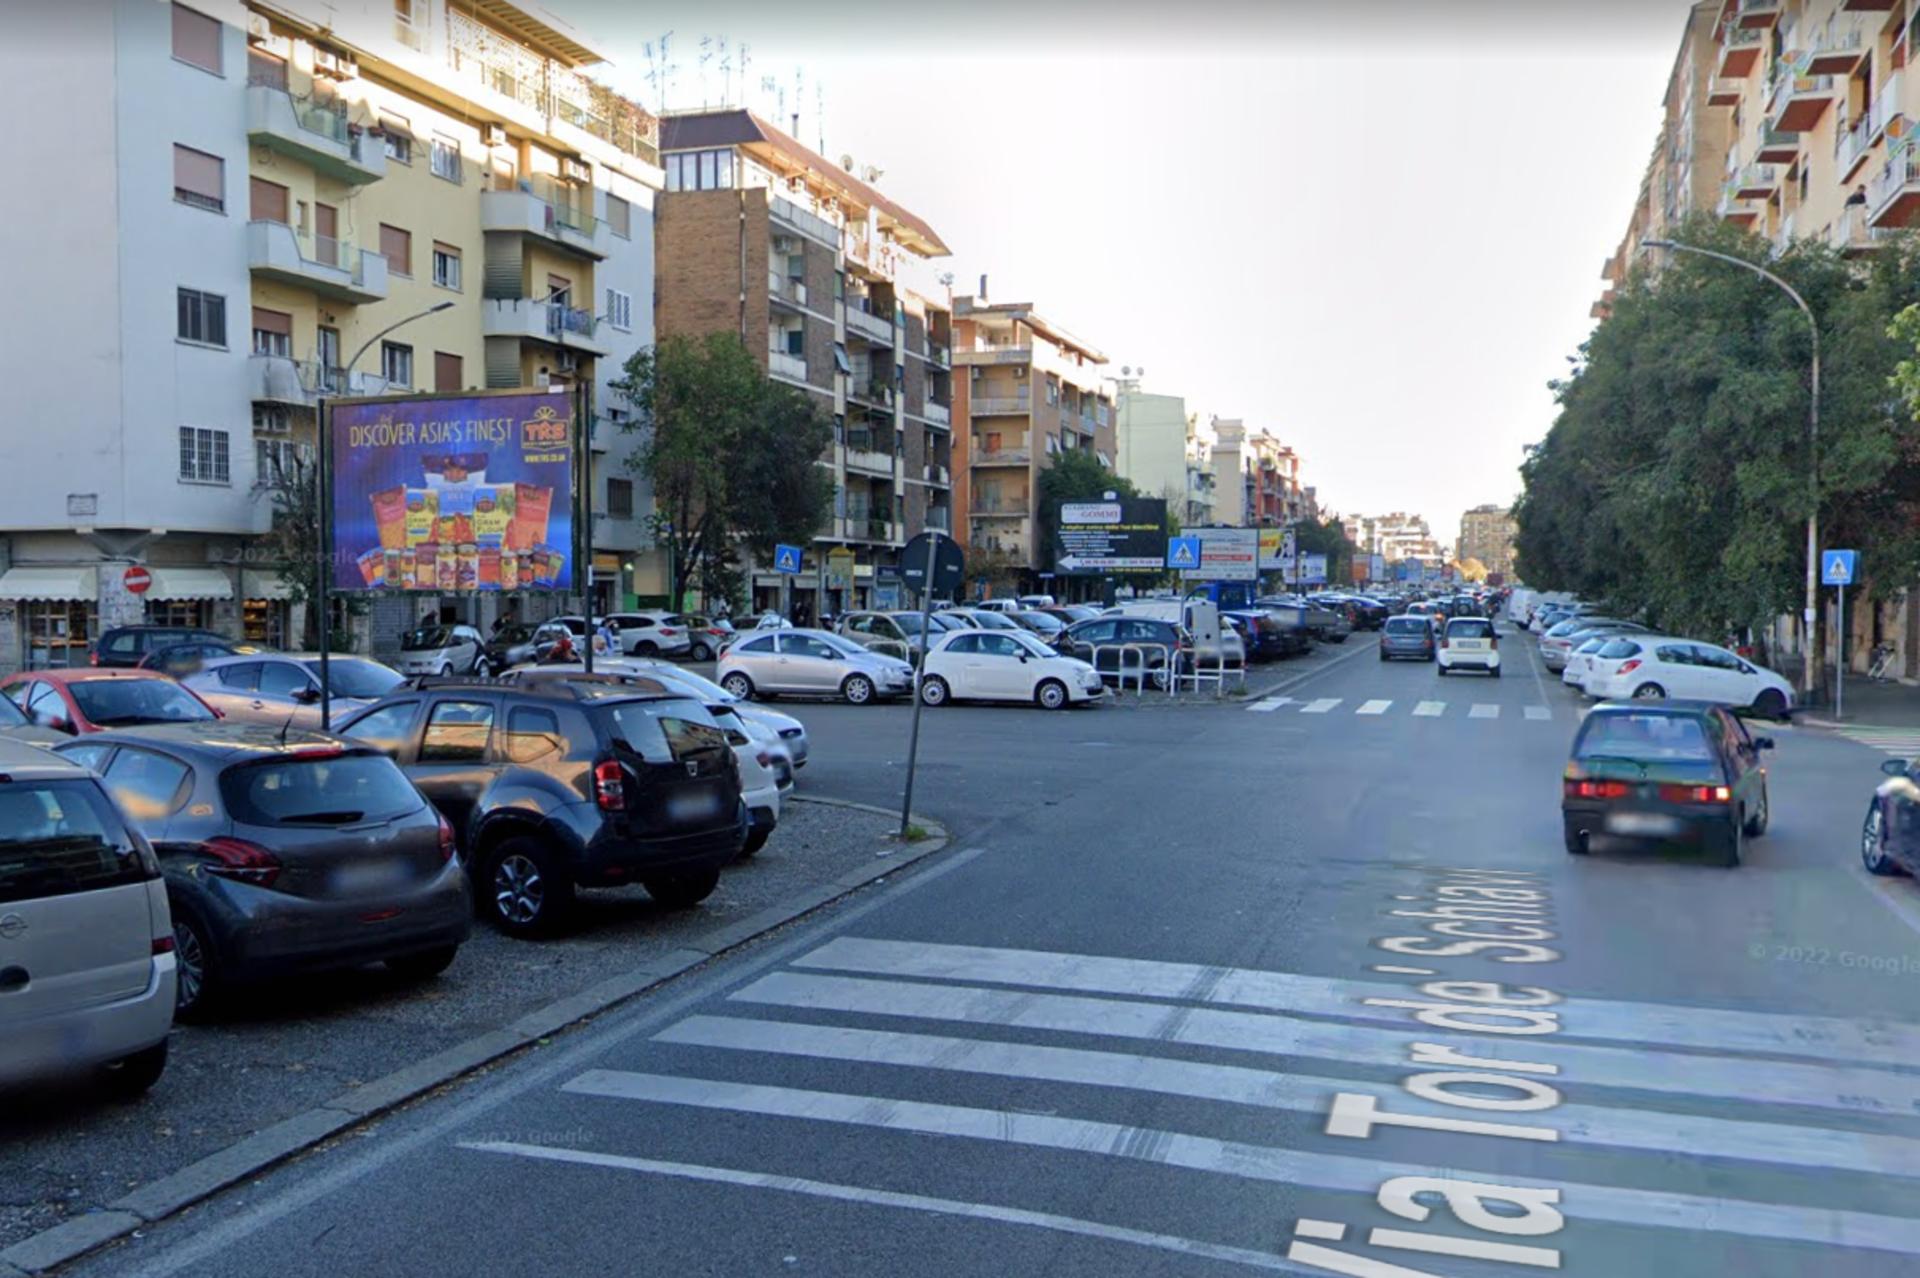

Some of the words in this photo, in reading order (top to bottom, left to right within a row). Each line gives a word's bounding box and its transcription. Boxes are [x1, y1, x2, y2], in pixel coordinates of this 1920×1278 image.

[350, 421, 416, 448] DISCOVER
[419, 419, 462, 445] ASIA'S
[467, 417, 514, 443] FINEST
[525, 421, 566, 441] TRS
